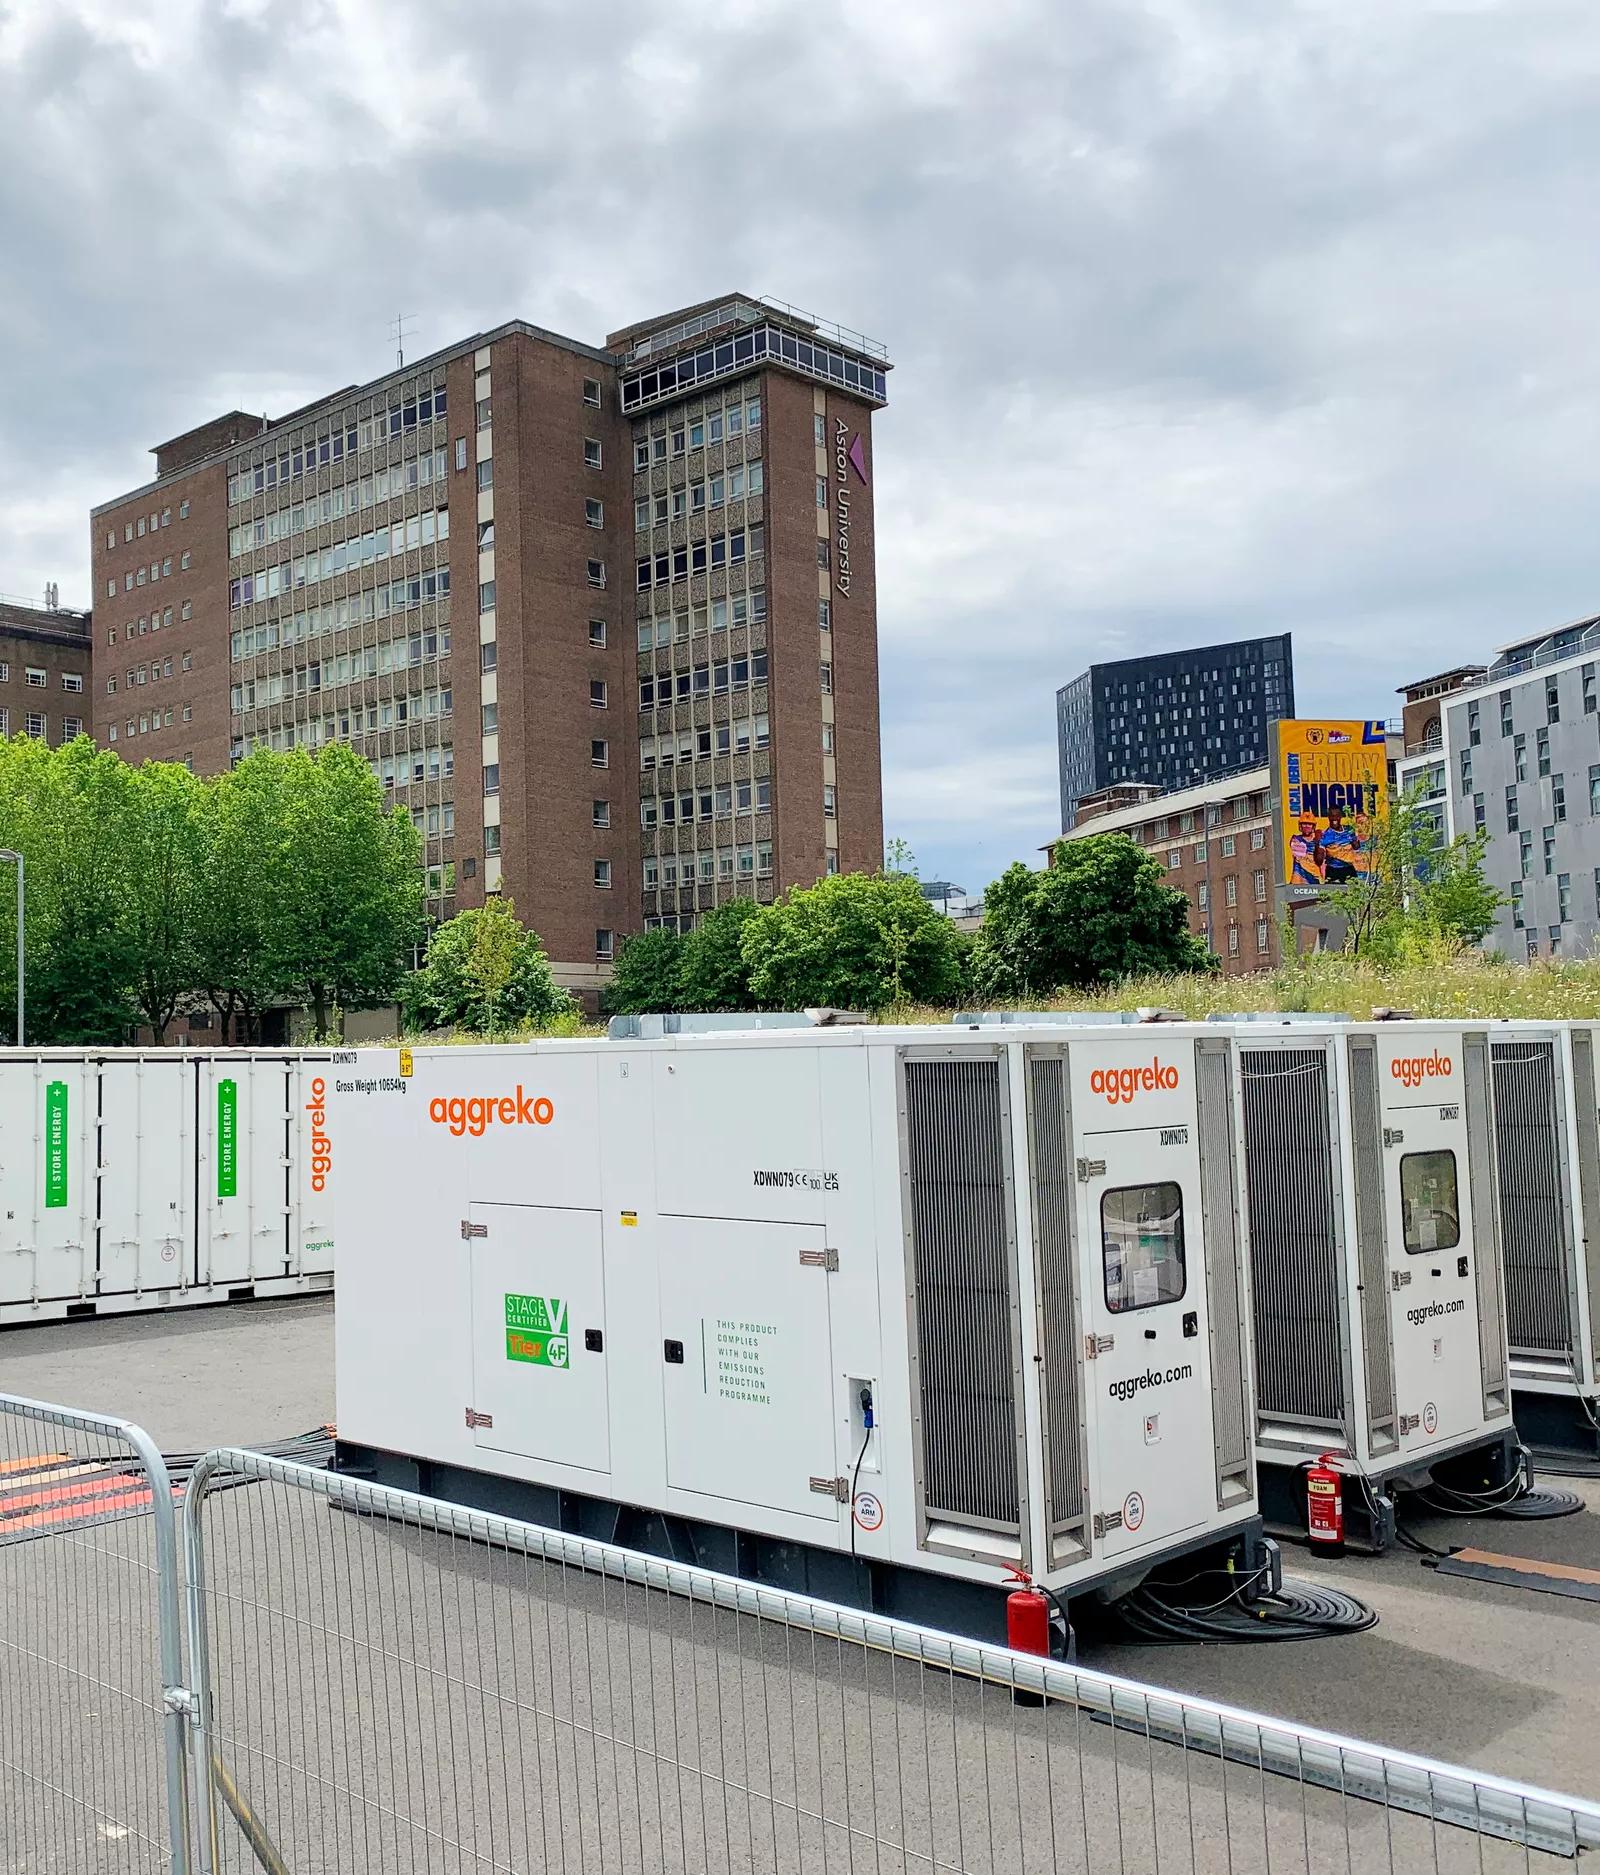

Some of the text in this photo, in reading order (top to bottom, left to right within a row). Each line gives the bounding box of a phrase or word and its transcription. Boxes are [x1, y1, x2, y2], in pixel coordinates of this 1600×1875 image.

[835, 417, 853, 599] Aston University
[1300, 751, 1380, 783] FRIDAY
[1301, 783, 1380, 817] NIGHT
[1293, 887, 1319, 895] OCEAN
[1391, 1047, 1452, 1088] aggreko
[335, 1077, 407, 1095] Gross Weight 10654kg
[1090, 1055, 1179, 1105] aggreko
[223, 1102, 232, 1139] ENERGY
[429, 1084, 554, 1137] aggreko
[52, 1105, 62, 1145] ENERGY
[305, 1076, 332, 1192] aggreko
[52, 1148, 62, 1182] STORE
[223, 1142, 232, 1173] STORE
[754, 1170, 794, 1188] XDWN079
[823, 1172, 838, 1182] UK
[824, 1181, 839, 1191] CA
[507, 1295, 545, 1317] STAGE
[1407, 1298, 1465, 1326] aggreko.com
[507, 1314, 549, 1327] CERTIFIED
[717, 1319, 777, 1335] THIS PRODUCT
[509, 1334, 567, 1361] Tier 4F
[717, 1334, 759, 1347] COMPLIES
[718, 1347, 759, 1361] WITH OUR
[718, 1361, 765, 1375] EMISSIONS
[719, 1375, 766, 1389] REDUCTION
[1108, 1363, 1193, 1401] aggreko.com
[720, 1388, 771, 1405] PROGRAMME
[861, 1508, 876, 1517] ARM
